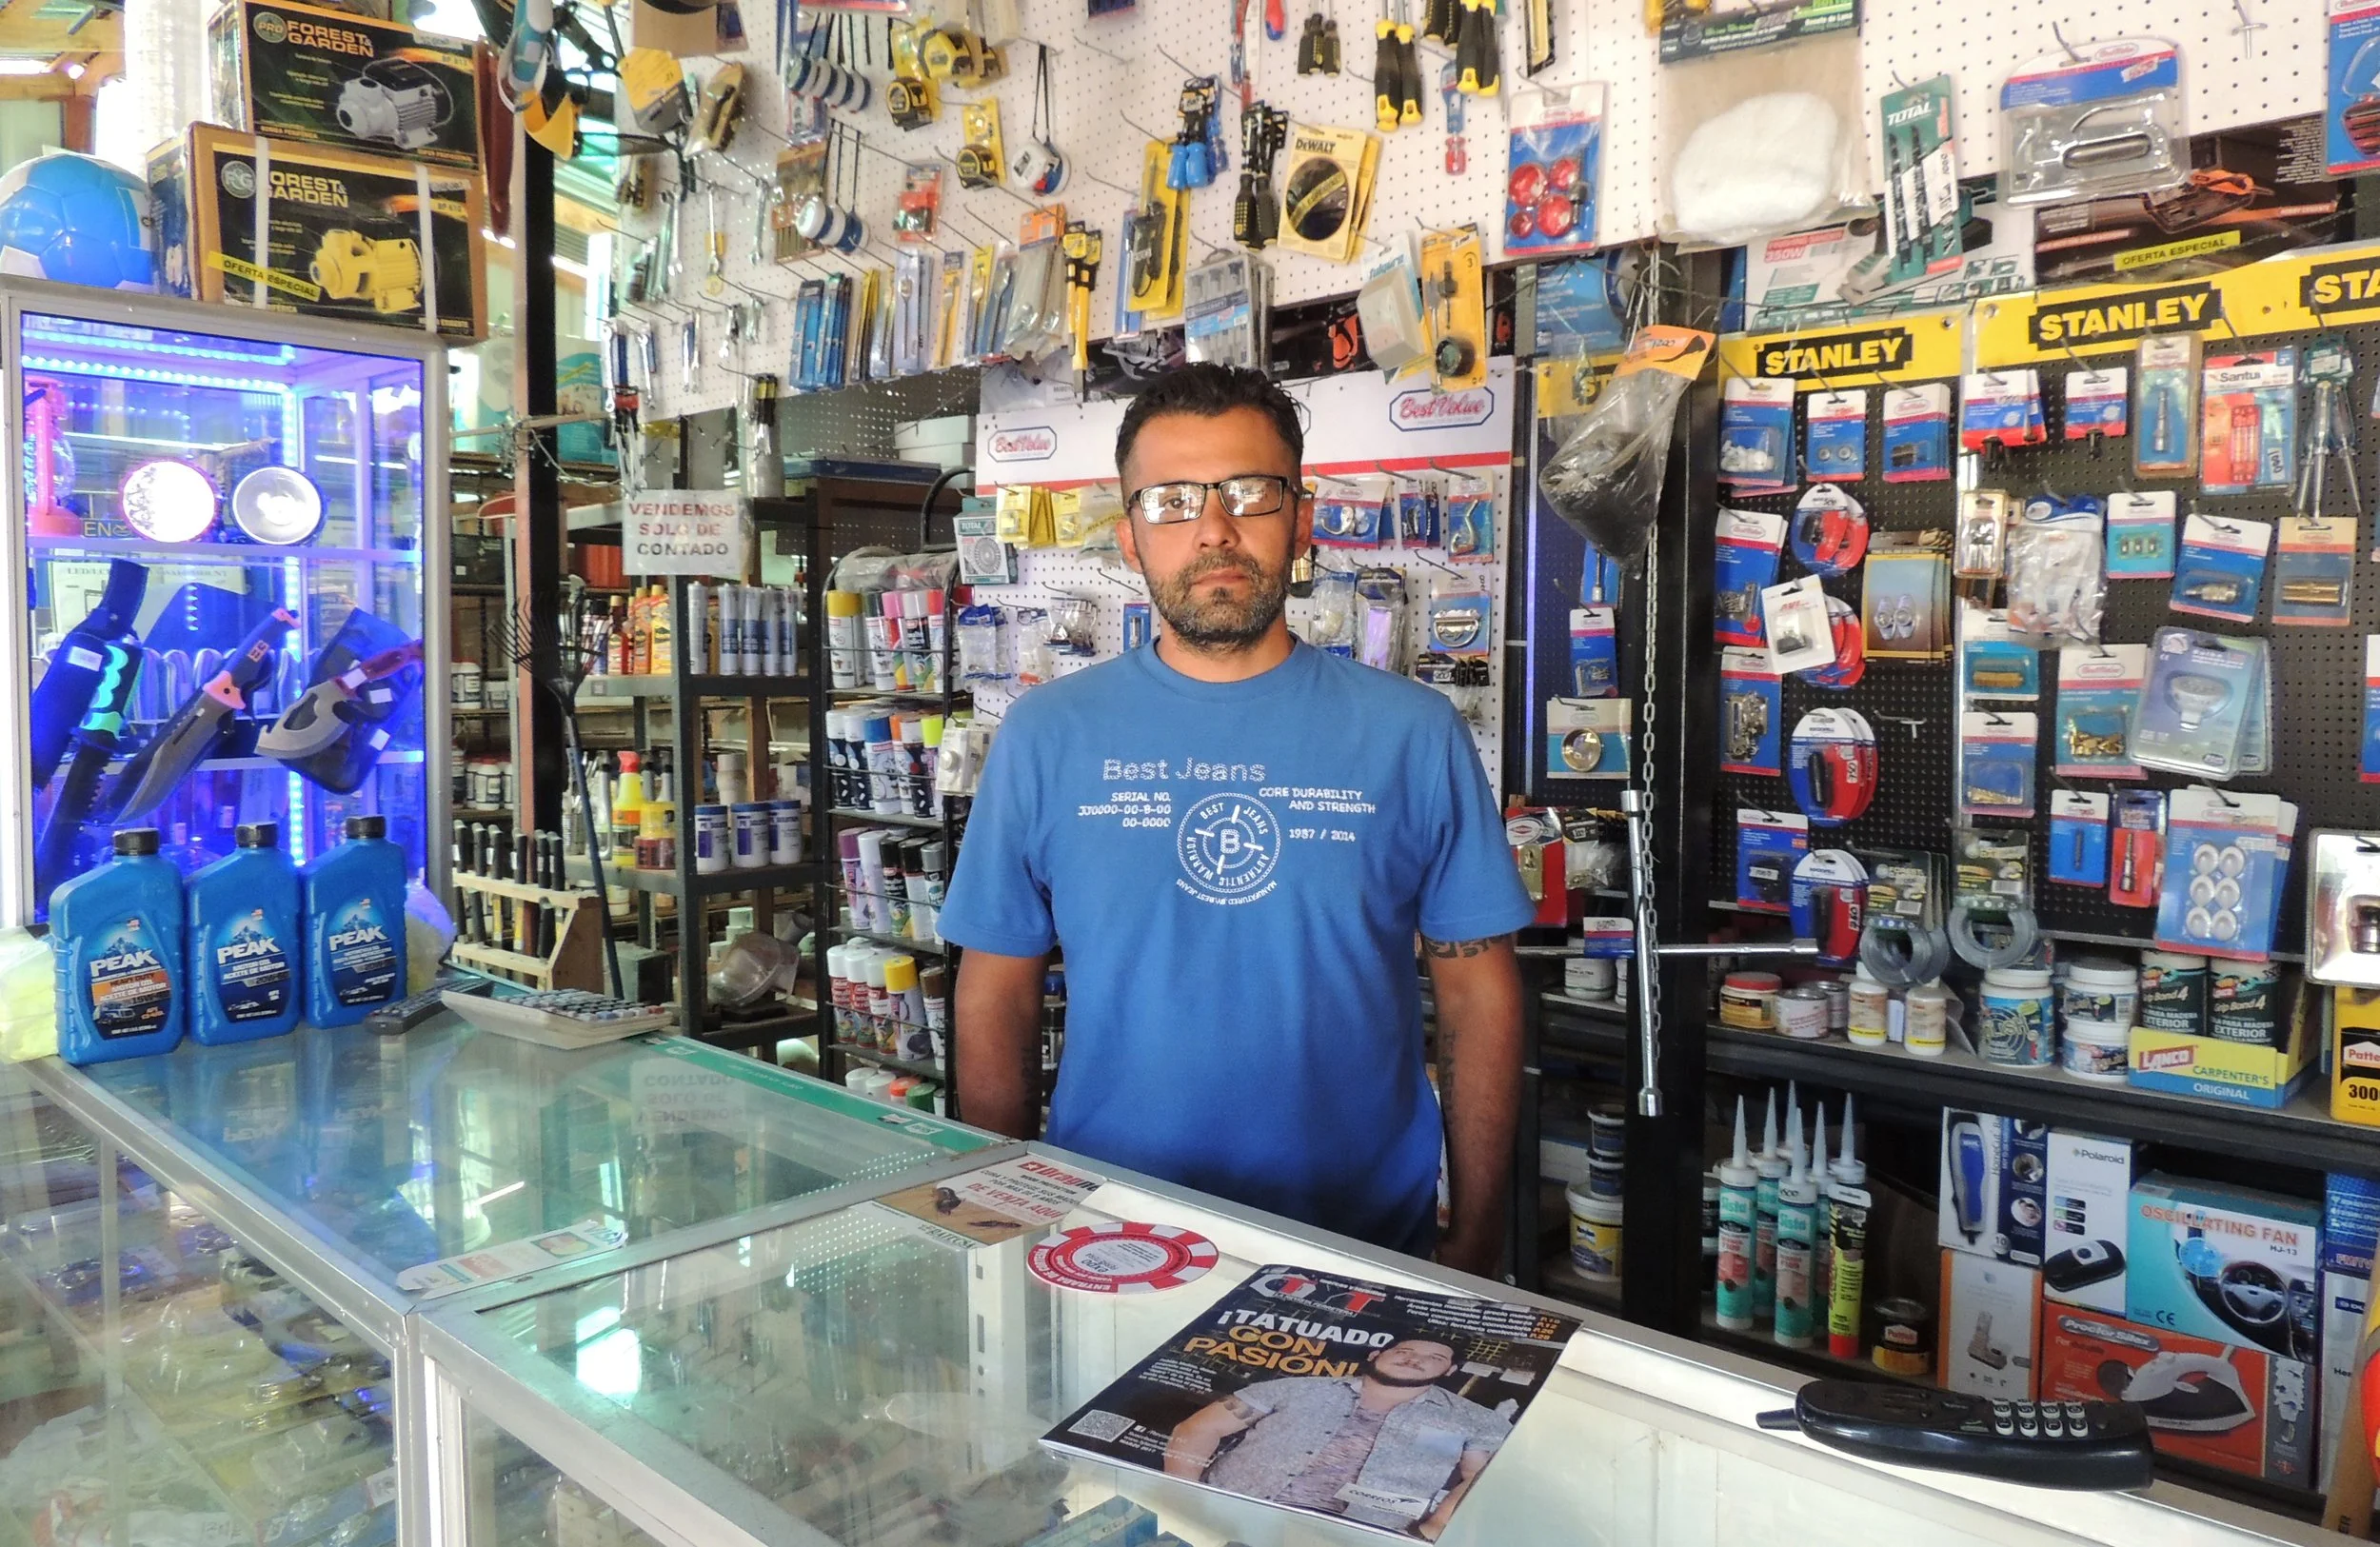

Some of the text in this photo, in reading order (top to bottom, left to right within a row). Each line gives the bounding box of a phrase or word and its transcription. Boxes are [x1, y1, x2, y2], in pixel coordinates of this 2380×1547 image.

[287, 20, 366, 45] FOREST
[288, 31, 374, 58] GARDEN
[1887, 102, 1932, 126] TOTAL
[268, 170, 342, 192] OREST
[2122, 239, 2227, 266] OFERTA ESPECIAL
[224, 260, 317, 298] OFERTA ESPECIAL
[2039, 292, 2209, 343] STANLEY
[1764, 337, 1903, 376] STANLEY
[1400, 392, 1485, 420] Best Value
[628, 503, 736, 517] VENDEMOS
[639, 523, 722, 536] SOLO DE
[637, 543, 729, 556] CONTADO
[1103, 757, 1266, 782] Best Jeans
[1112, 791, 1150, 802] SERIAL
[1259, 787, 1362, 801] CORE DURABILITY
[1200, 802, 1268, 835] BEST JEANS
[1289, 801, 1376, 814] AND STRENGTH
[1220, 828, 1241, 854] B
[1186, 836, 1271, 887] AUTHENTIC WARRIOR
[217, 937, 282, 964] PEAK
[329, 925, 388, 952] PEAK
[89, 949, 160, 978] PEAK
[2213, 1025, 2267, 1038] EXTERIOR
[2143, 1049, 2190, 1070] LANCO
[2192, 1065, 2270, 1085] CARPENTER'S
[2193, 1082, 2250, 1100] ORIGINAL
[2081, 1149, 2125, 1164] Polaroid
[967, 1181, 989, 1193] DE
[986, 1189, 1029, 1207] VENTA
[2140, 1203, 2298, 1246] OSCILLATING FAN
[2270, 1244, 2298, 1256] HJ-13
[1081, 1259, 1110, 1273] expo
[1056, 1276, 1112, 1291] ENTRADA
[1217, 1309, 1394, 1348] ¡TATUADO
[1183, 1337, 1359, 1377] PASIÓN!
